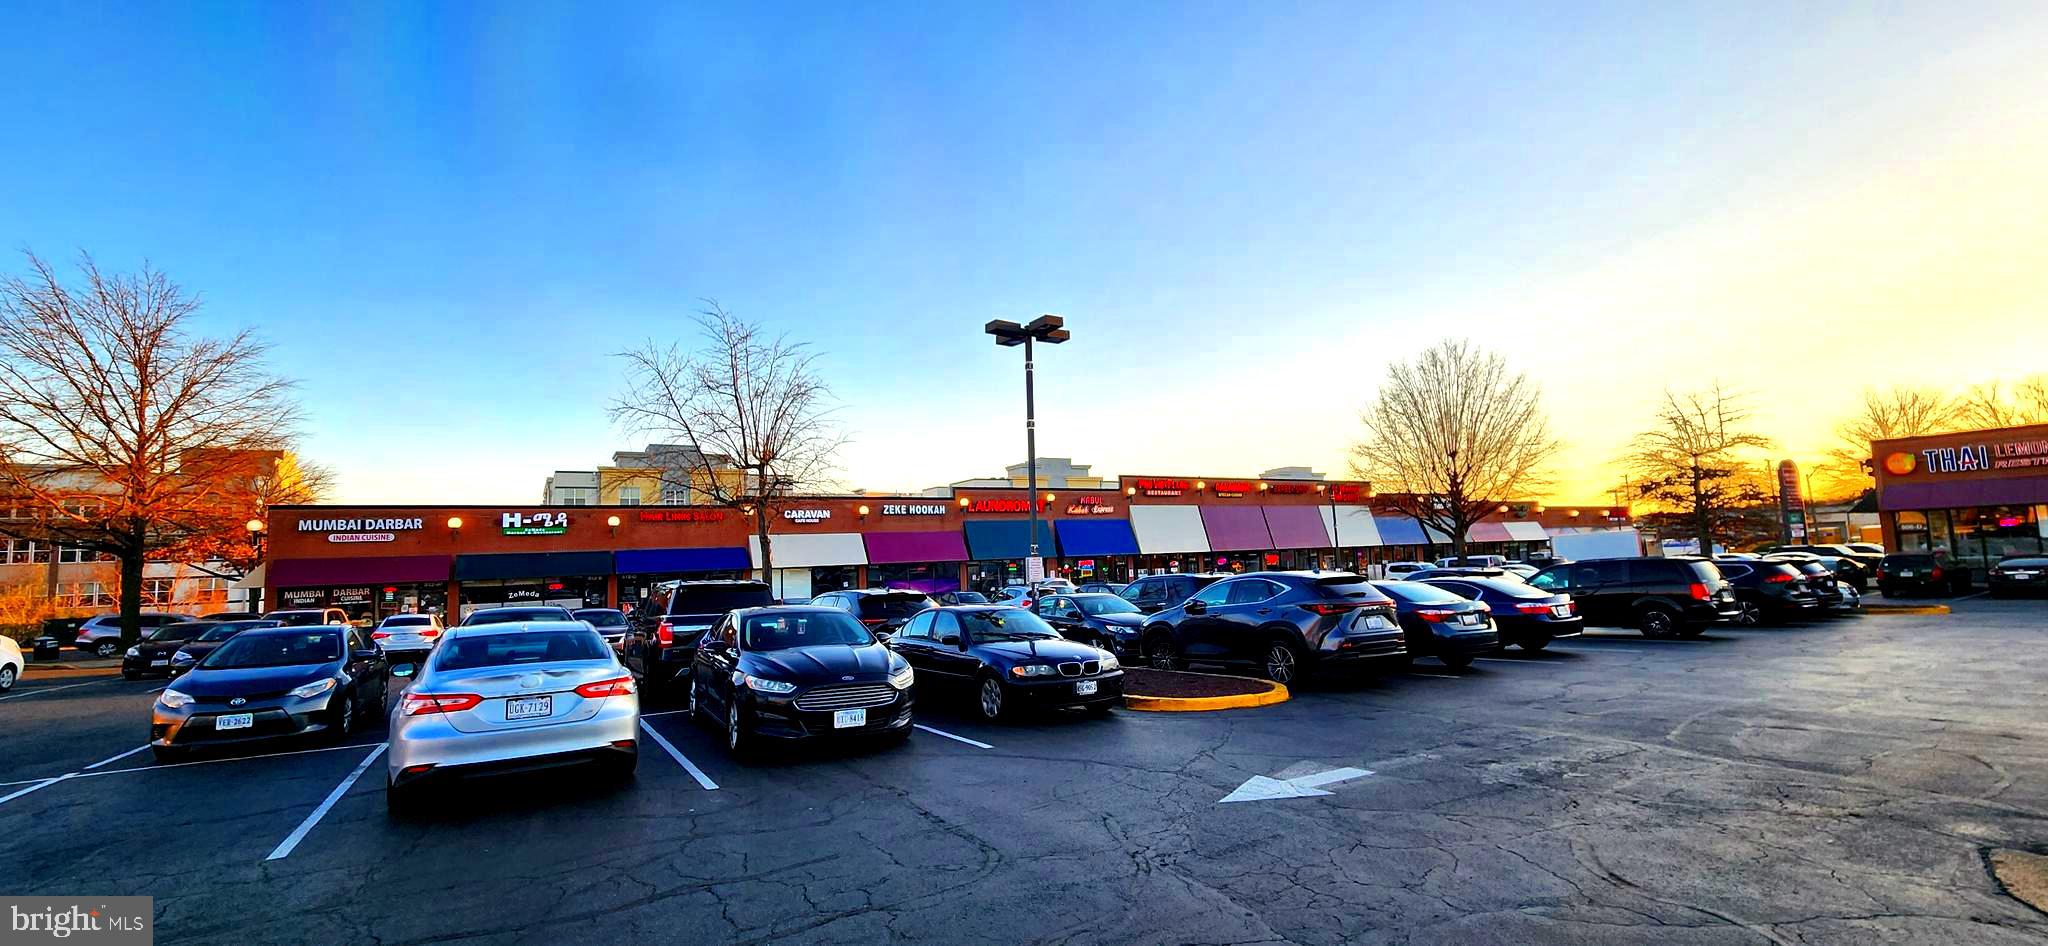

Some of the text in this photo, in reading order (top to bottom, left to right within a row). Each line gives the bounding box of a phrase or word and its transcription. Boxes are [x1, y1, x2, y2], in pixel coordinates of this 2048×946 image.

[1922, 444, 1989, 473] THAI
[1080, 496, 1103, 504] KABUL
[784, 509, 831, 519] CARAVAN
[883, 504, 946, 515] ZEKE HOOKAH
[693, 511, 724, 520] SALON
[298, 518, 423, 531] MUMBAI DARBAR
[361, 533, 391, 541] CUISINE
[284, 587, 370, 599] MUMBAI DARBAR
[508, 590, 540, 599] ZeMeda
